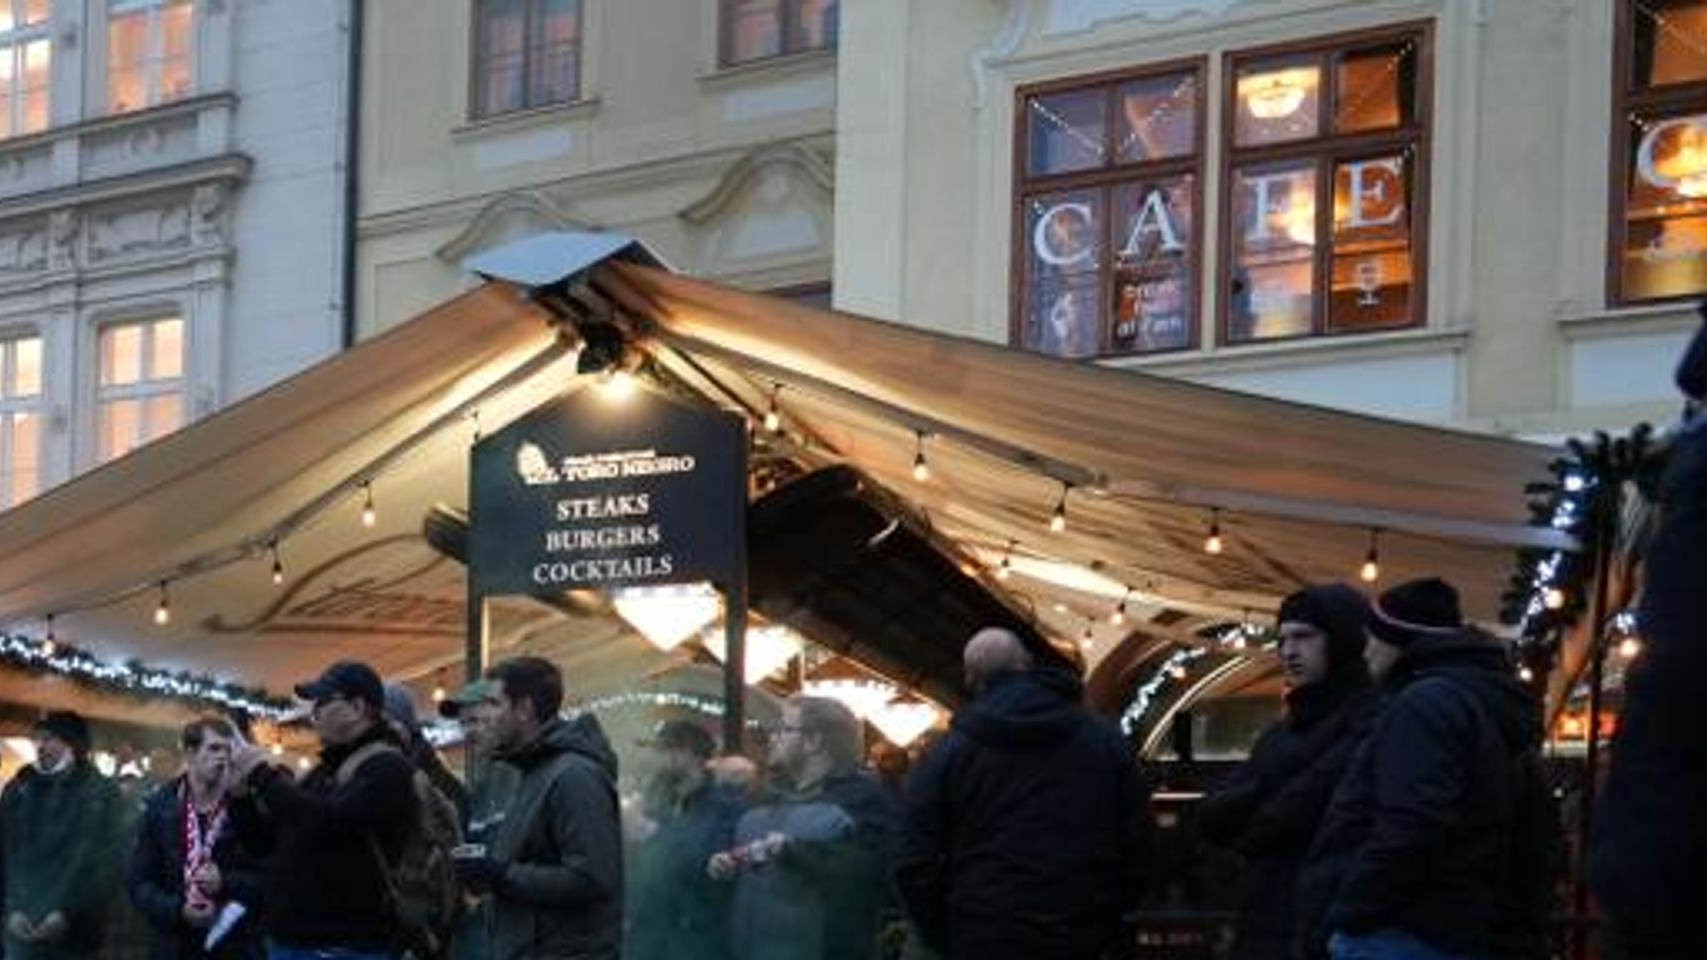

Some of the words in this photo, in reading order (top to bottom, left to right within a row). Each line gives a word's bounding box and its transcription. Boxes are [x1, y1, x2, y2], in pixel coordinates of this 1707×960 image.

[622, 456, 695, 477] NEGRO
[556, 494, 649, 521] STEAKS
[546, 524, 660, 552] BURGERS
[533, 554, 673, 583] COCKTAILS
